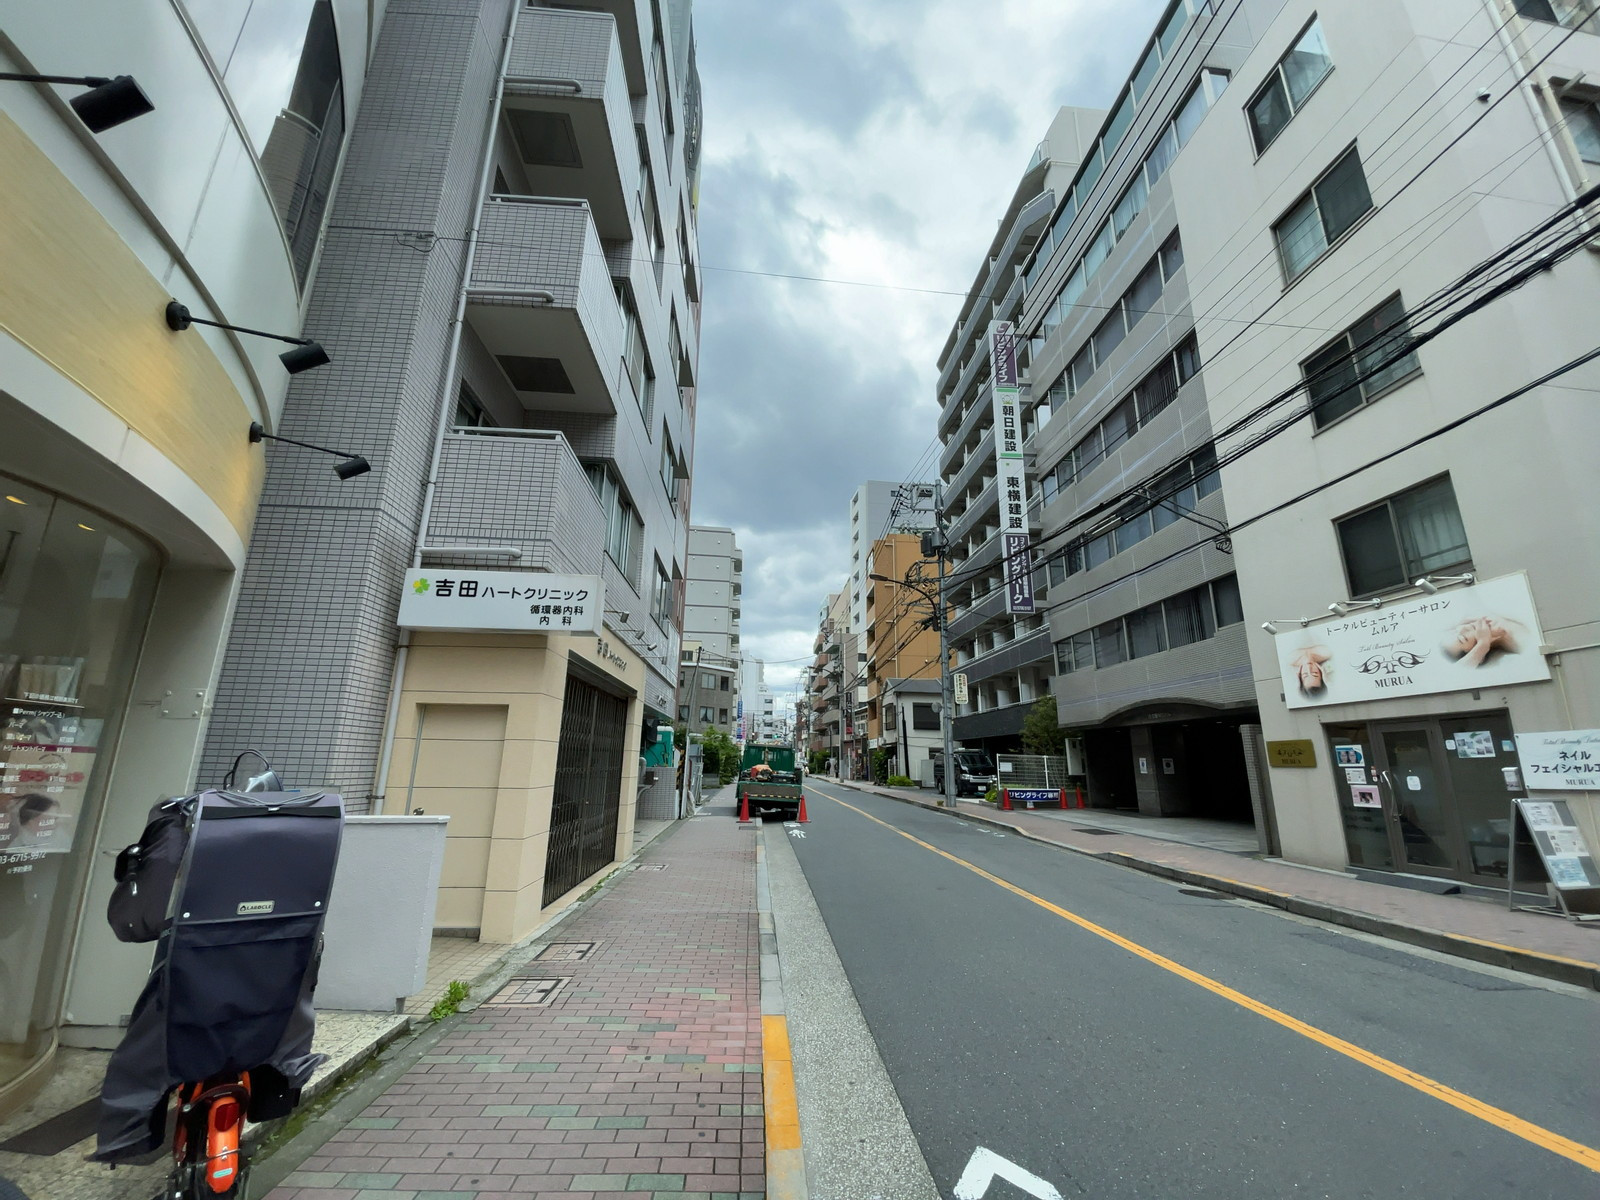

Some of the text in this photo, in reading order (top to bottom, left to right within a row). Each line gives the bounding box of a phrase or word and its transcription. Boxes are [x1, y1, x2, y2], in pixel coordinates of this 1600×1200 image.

[1002, 405, 1017, 452] 朝日建設
[1006, 476, 1023, 529] 東横建設
[435, 578, 589, 601] 吉田ハートクリニック
[530, 604, 584, 615] 循環器内科
[1326, 600, 1451, 636] トータルビューティーサロン
[1371, 622, 1399, 636] ムルア
[1374, 675, 1413, 688] MURUA
[1559, 750, 1592, 761] ネイル
